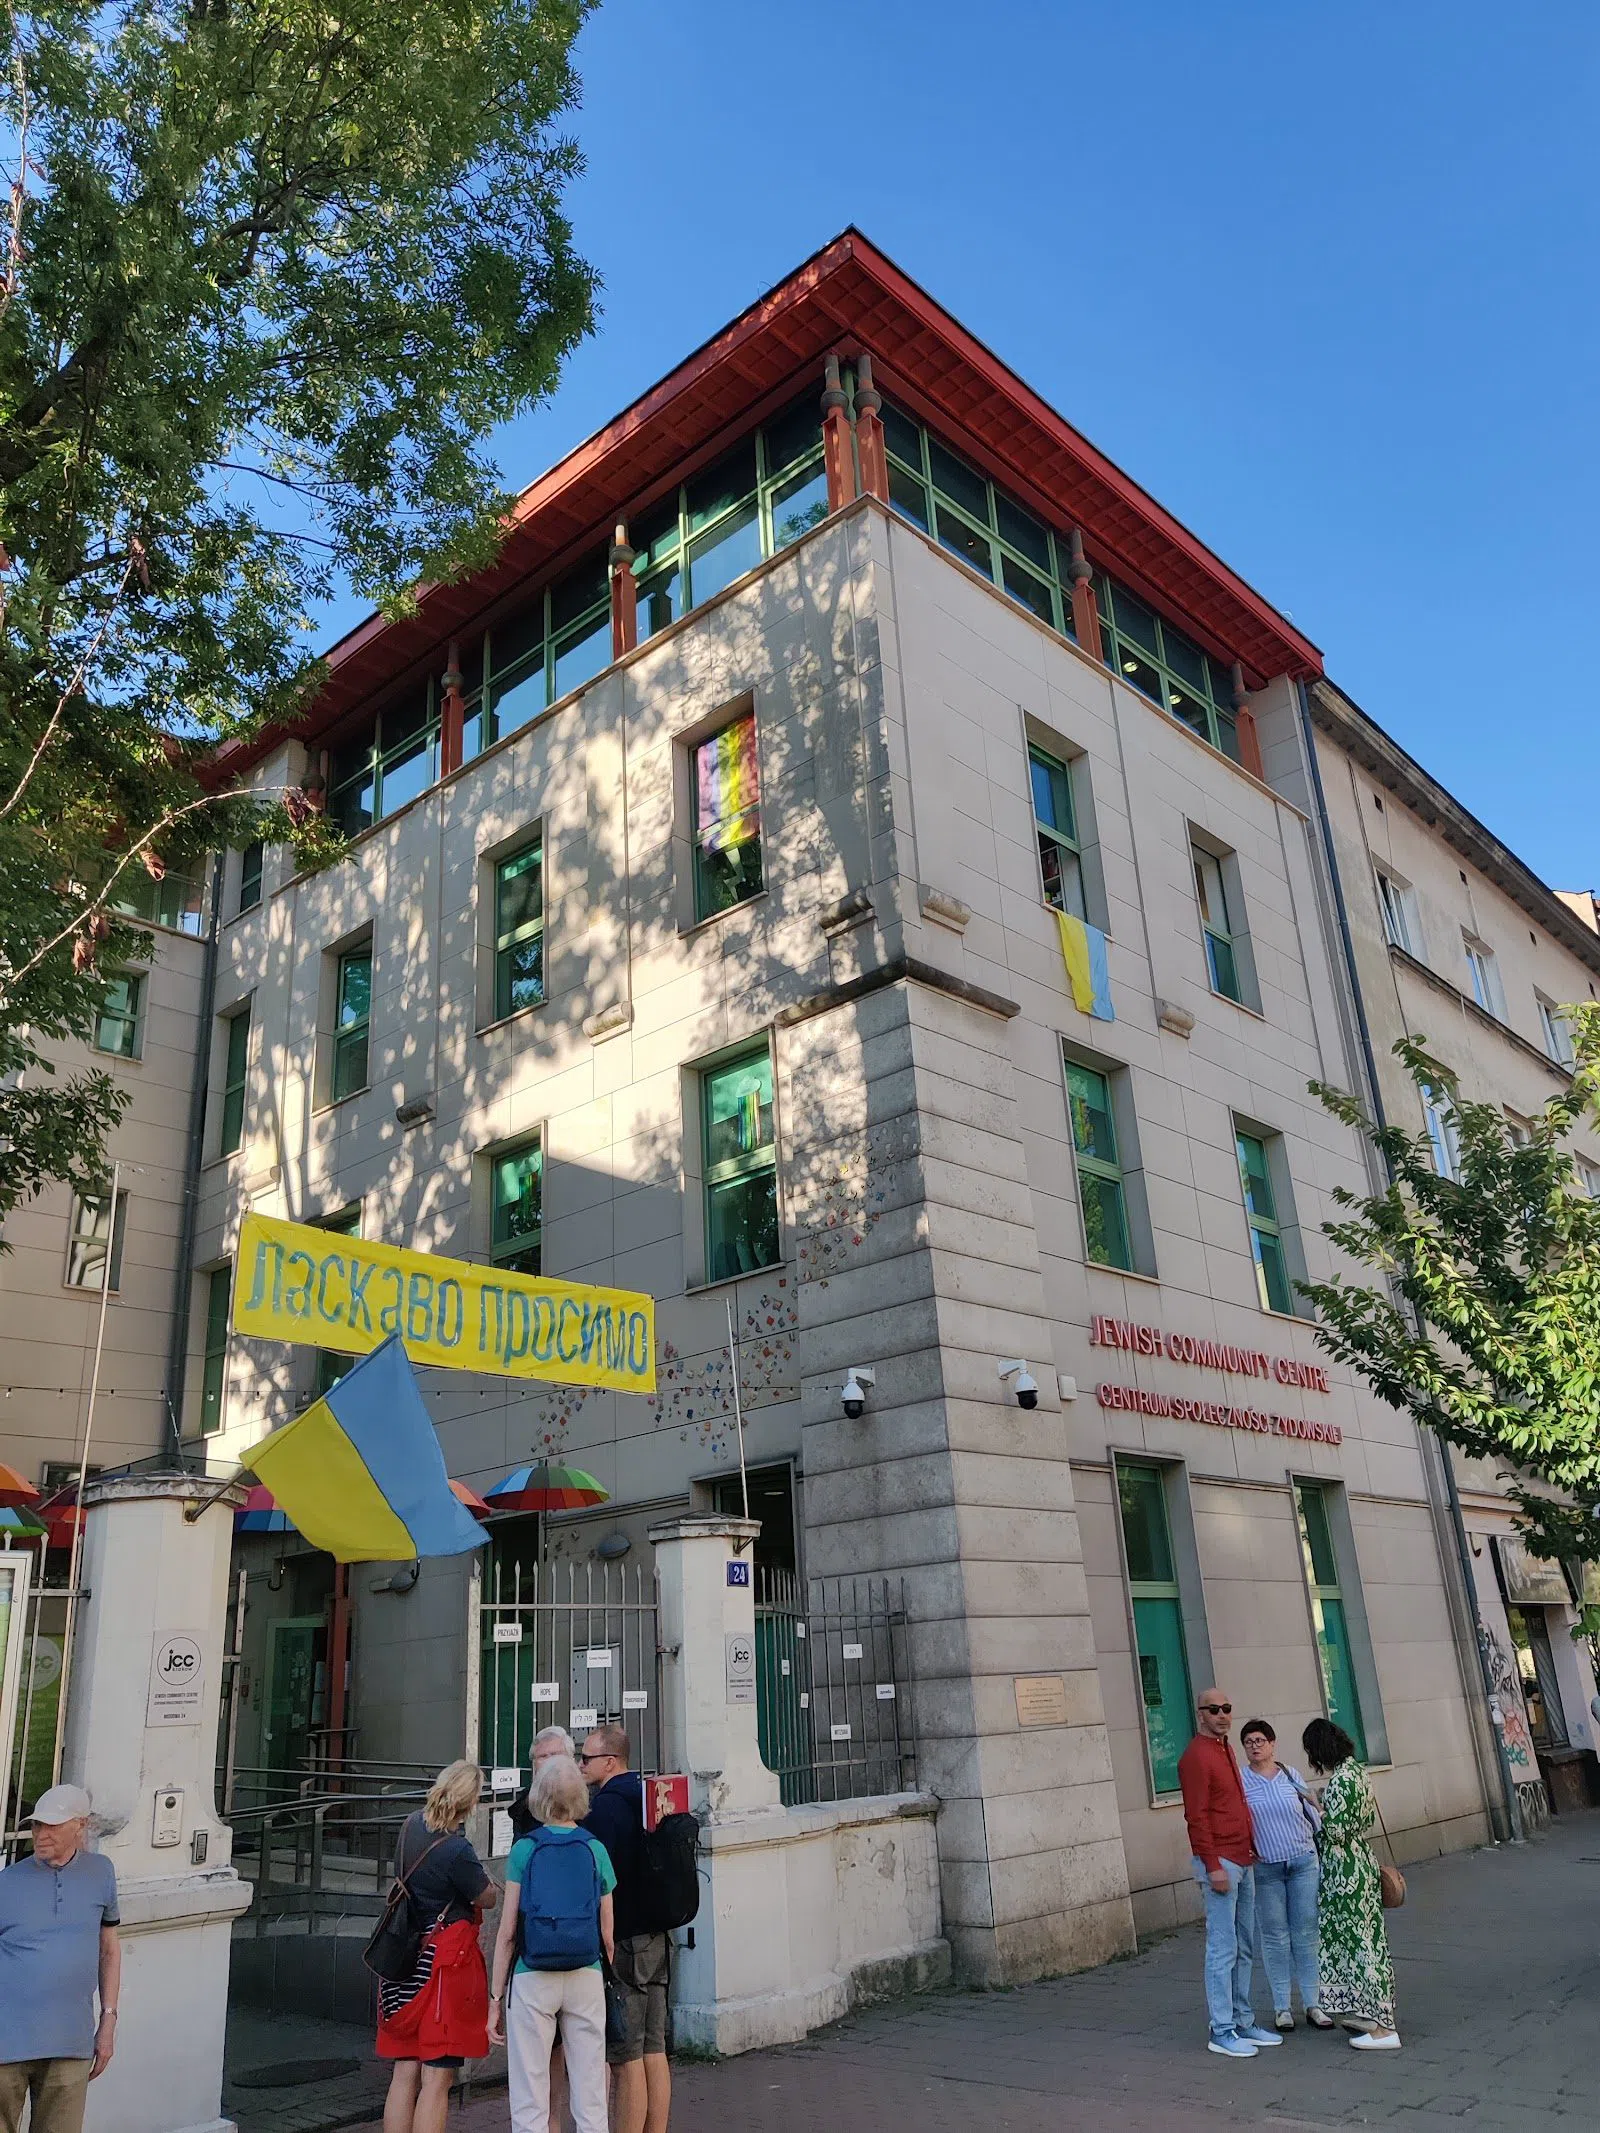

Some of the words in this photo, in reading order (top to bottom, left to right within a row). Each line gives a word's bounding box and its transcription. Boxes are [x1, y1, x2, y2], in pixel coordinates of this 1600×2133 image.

[244, 1239, 463, 1348] Ласкаво
[479, 1284, 648, 1376] просимо
[1091, 1315, 1164, 1356] JEWISH
[1167, 1333, 1269, 1380] COMMUNITY
[1274, 1357, 1330, 1393] CENTRE
[1097, 1383, 1173, 1417] CENTRUM
[734, 1565, 745, 1582] 24
[164, 1649, 194, 1671] jcc
[733, 1647, 749, 1663] jcc
[540, 1687, 551, 1696] HOPE
